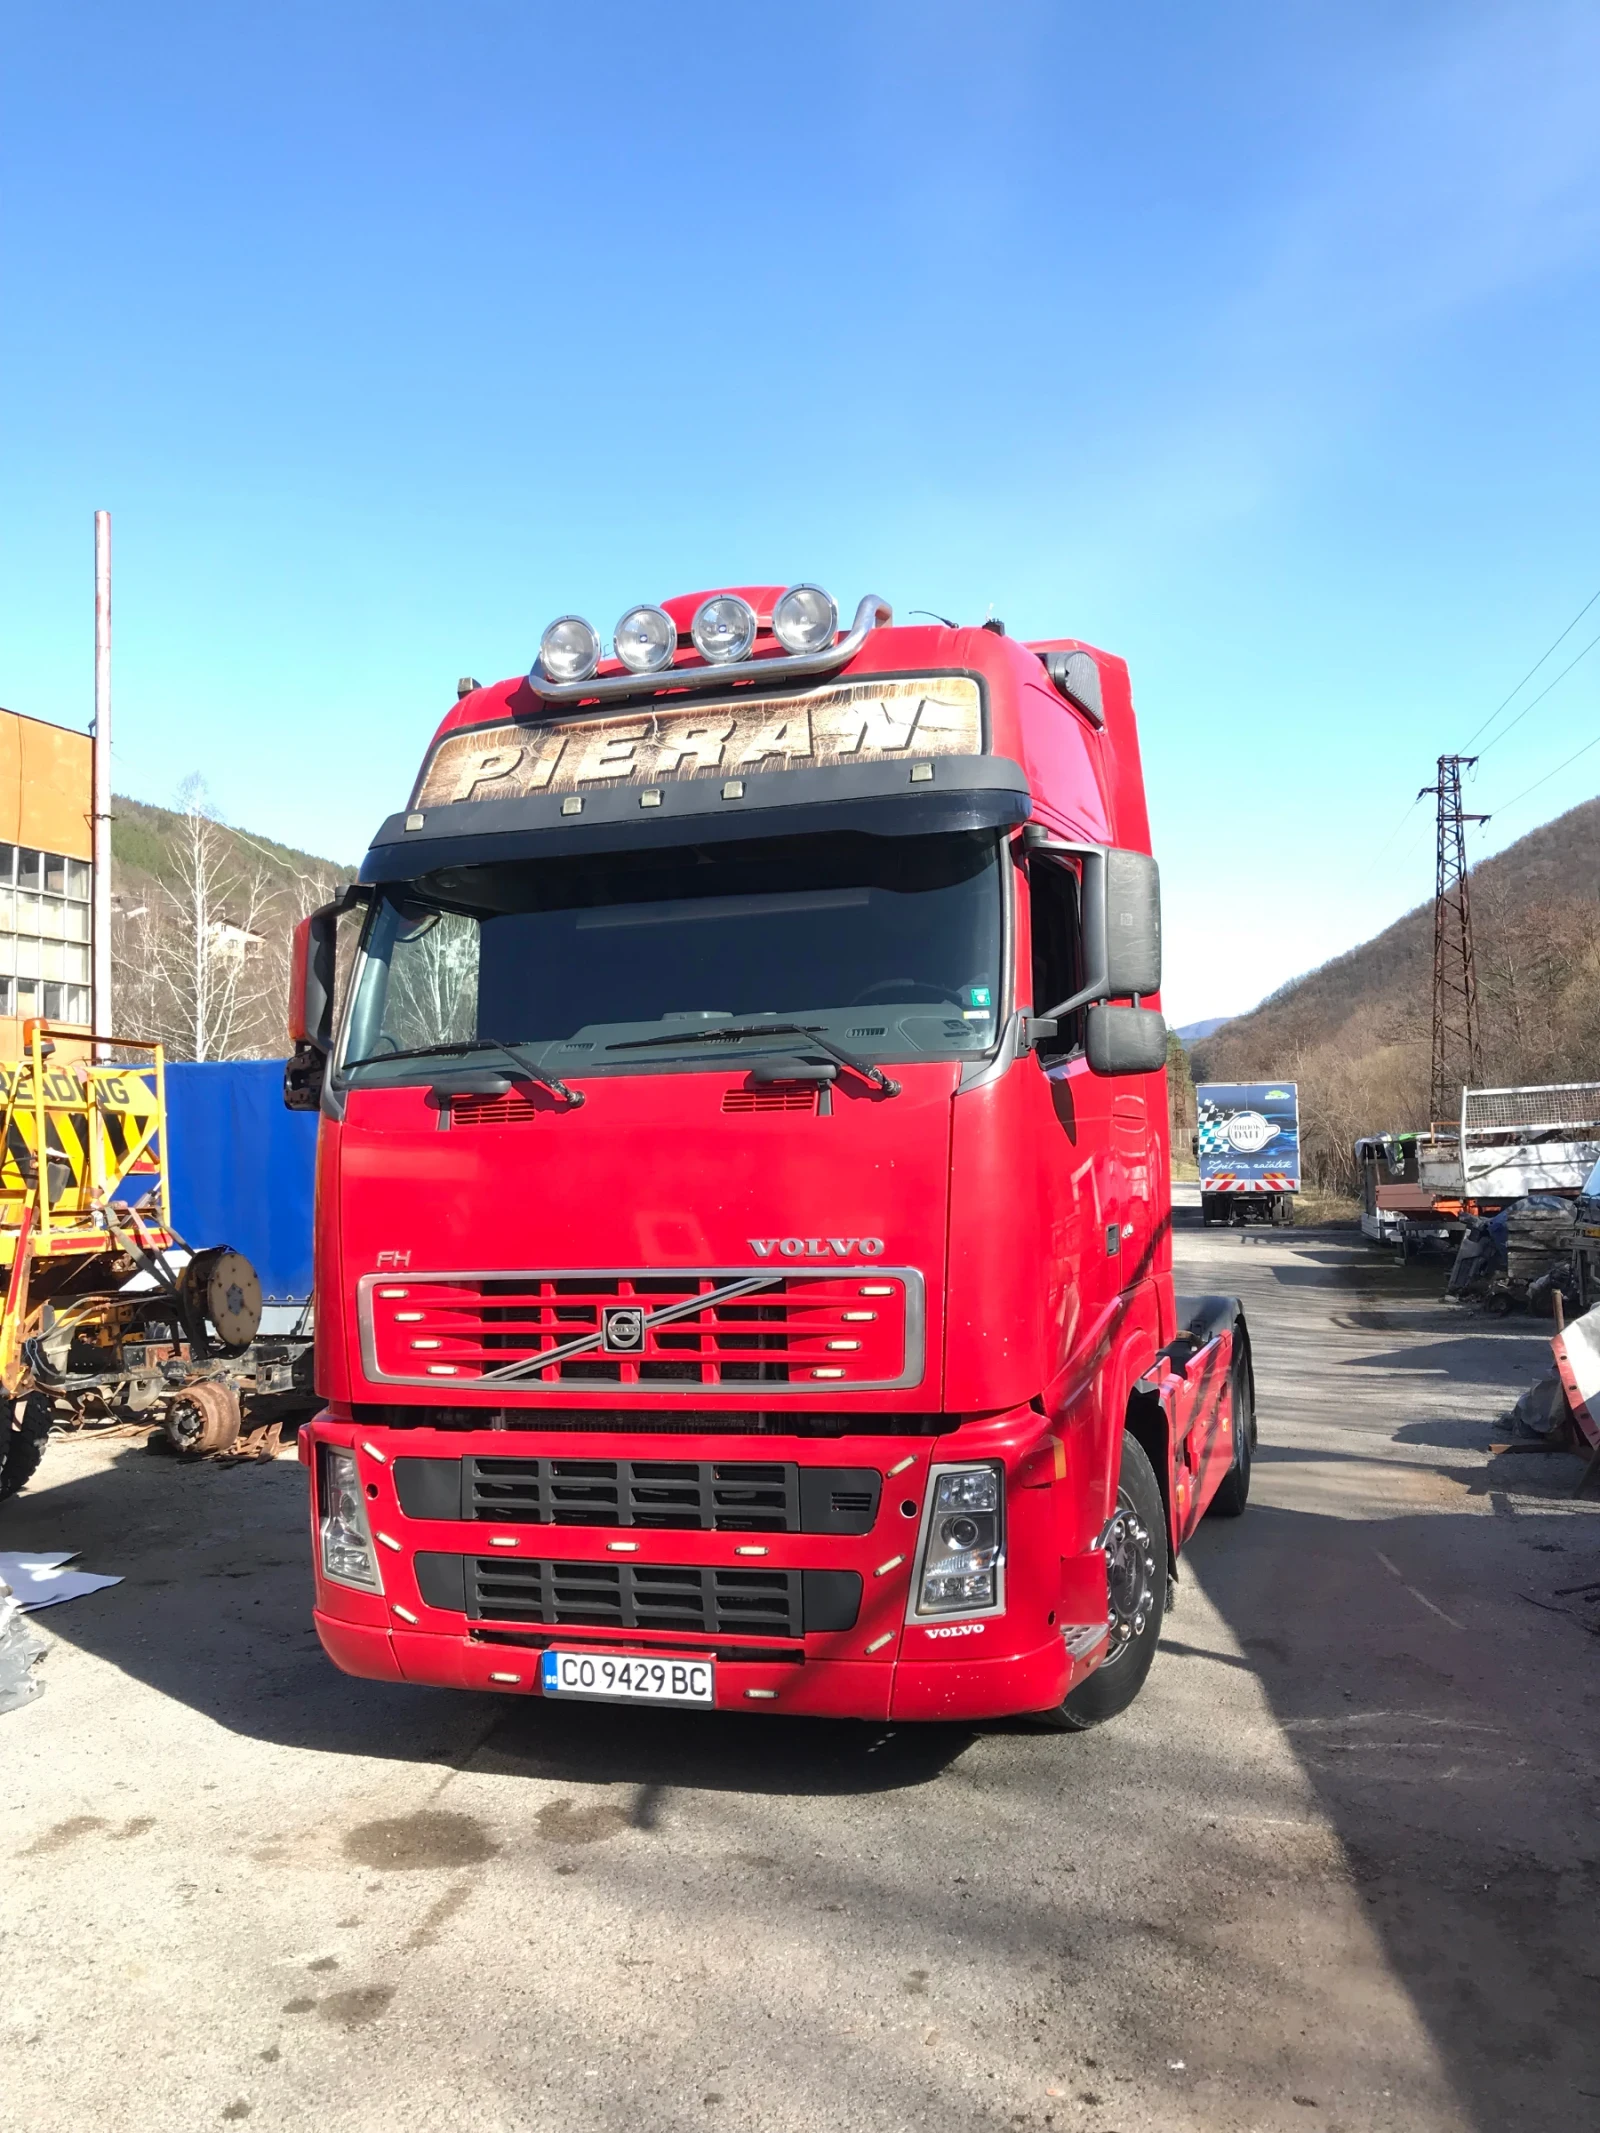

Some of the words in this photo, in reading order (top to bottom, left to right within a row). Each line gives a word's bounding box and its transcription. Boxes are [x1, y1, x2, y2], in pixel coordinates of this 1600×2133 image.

[450, 694, 928, 803] PIERAN
[747, 1237, 884, 1257] VOLVO
[376, 1250, 411, 1267] FH
[925, 1624, 985, 1639] VOLVO
[545, 1675, 557, 1684] BG
[562, 1658, 595, 1687] CO
[602, 1661, 665, 1693] 9429
[671, 1666, 707, 1696] BC
